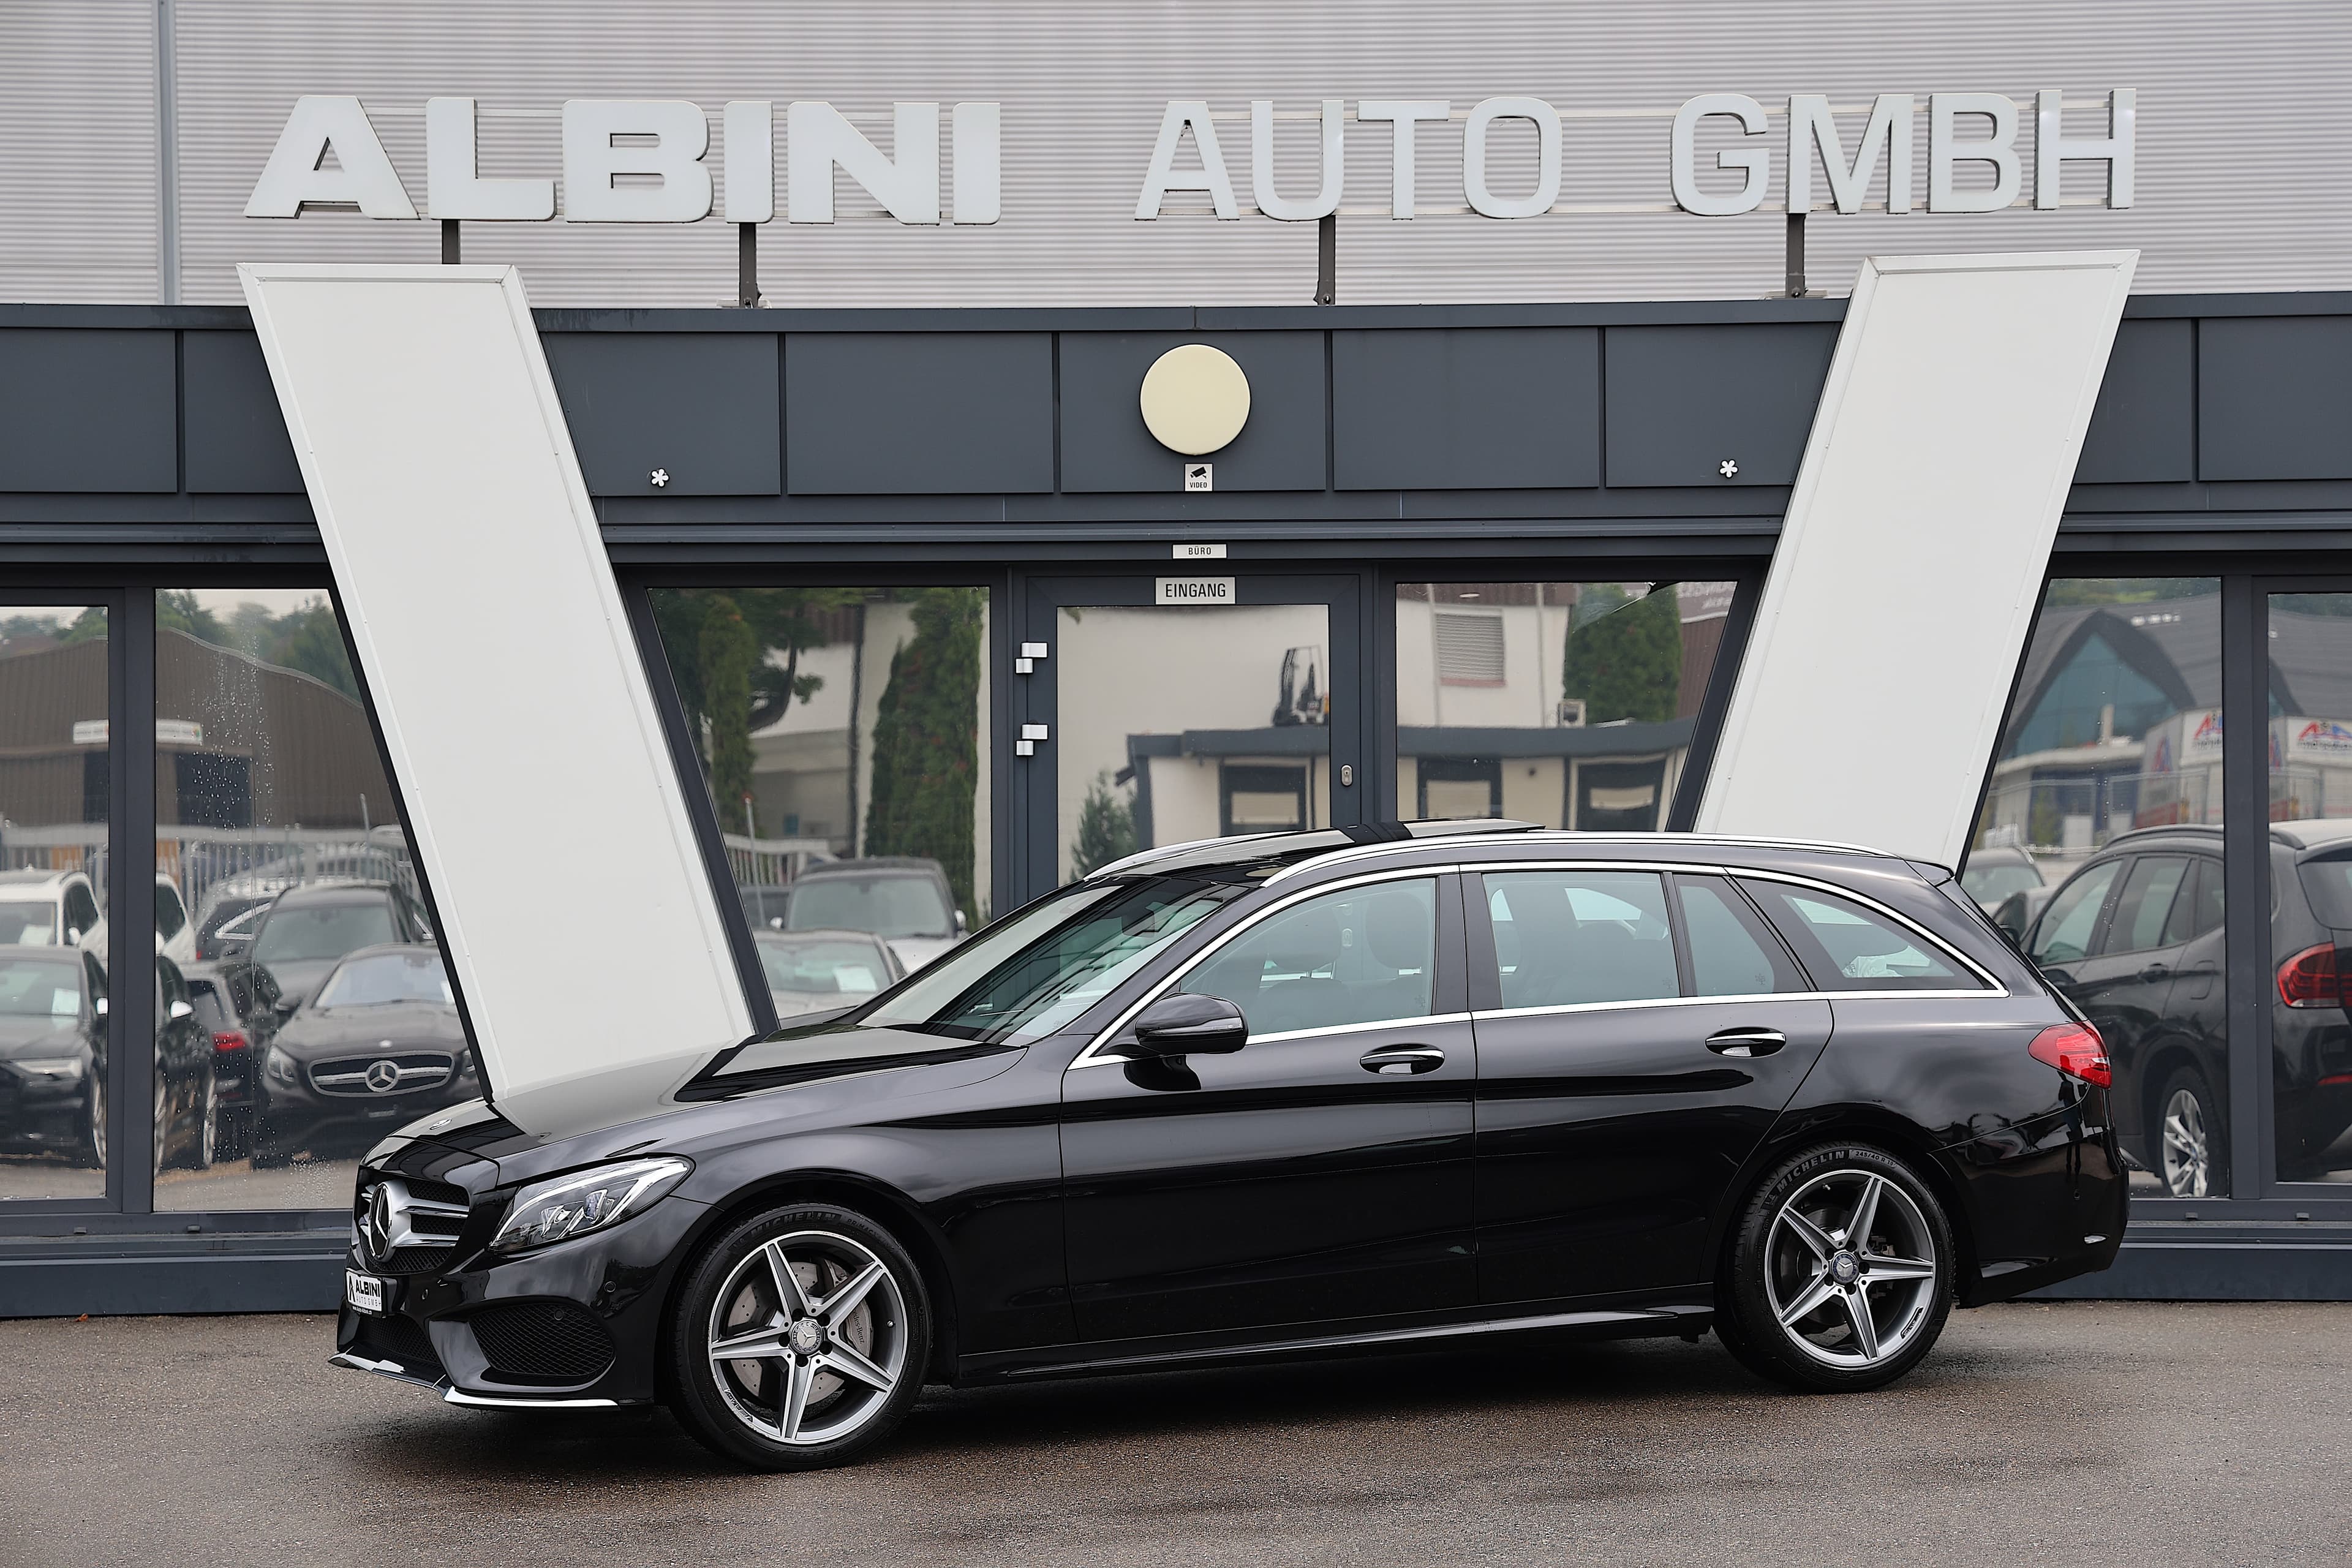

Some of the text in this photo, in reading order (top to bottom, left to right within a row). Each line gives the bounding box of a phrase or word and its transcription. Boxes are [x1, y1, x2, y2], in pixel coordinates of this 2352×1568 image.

[244, 88, 2138, 225] ALBINI AUTO GMBH
[1188, 545, 1212, 555] BÜRO
[1165, 583, 1226, 598] EINGANG
[1855, 1151, 1879, 1160] 245/40
[1776, 1150, 1844, 1193] MICHELIN
[750, 1212, 835, 1237] MICHELIN
[355, 1279, 380, 1297] ALBINI
